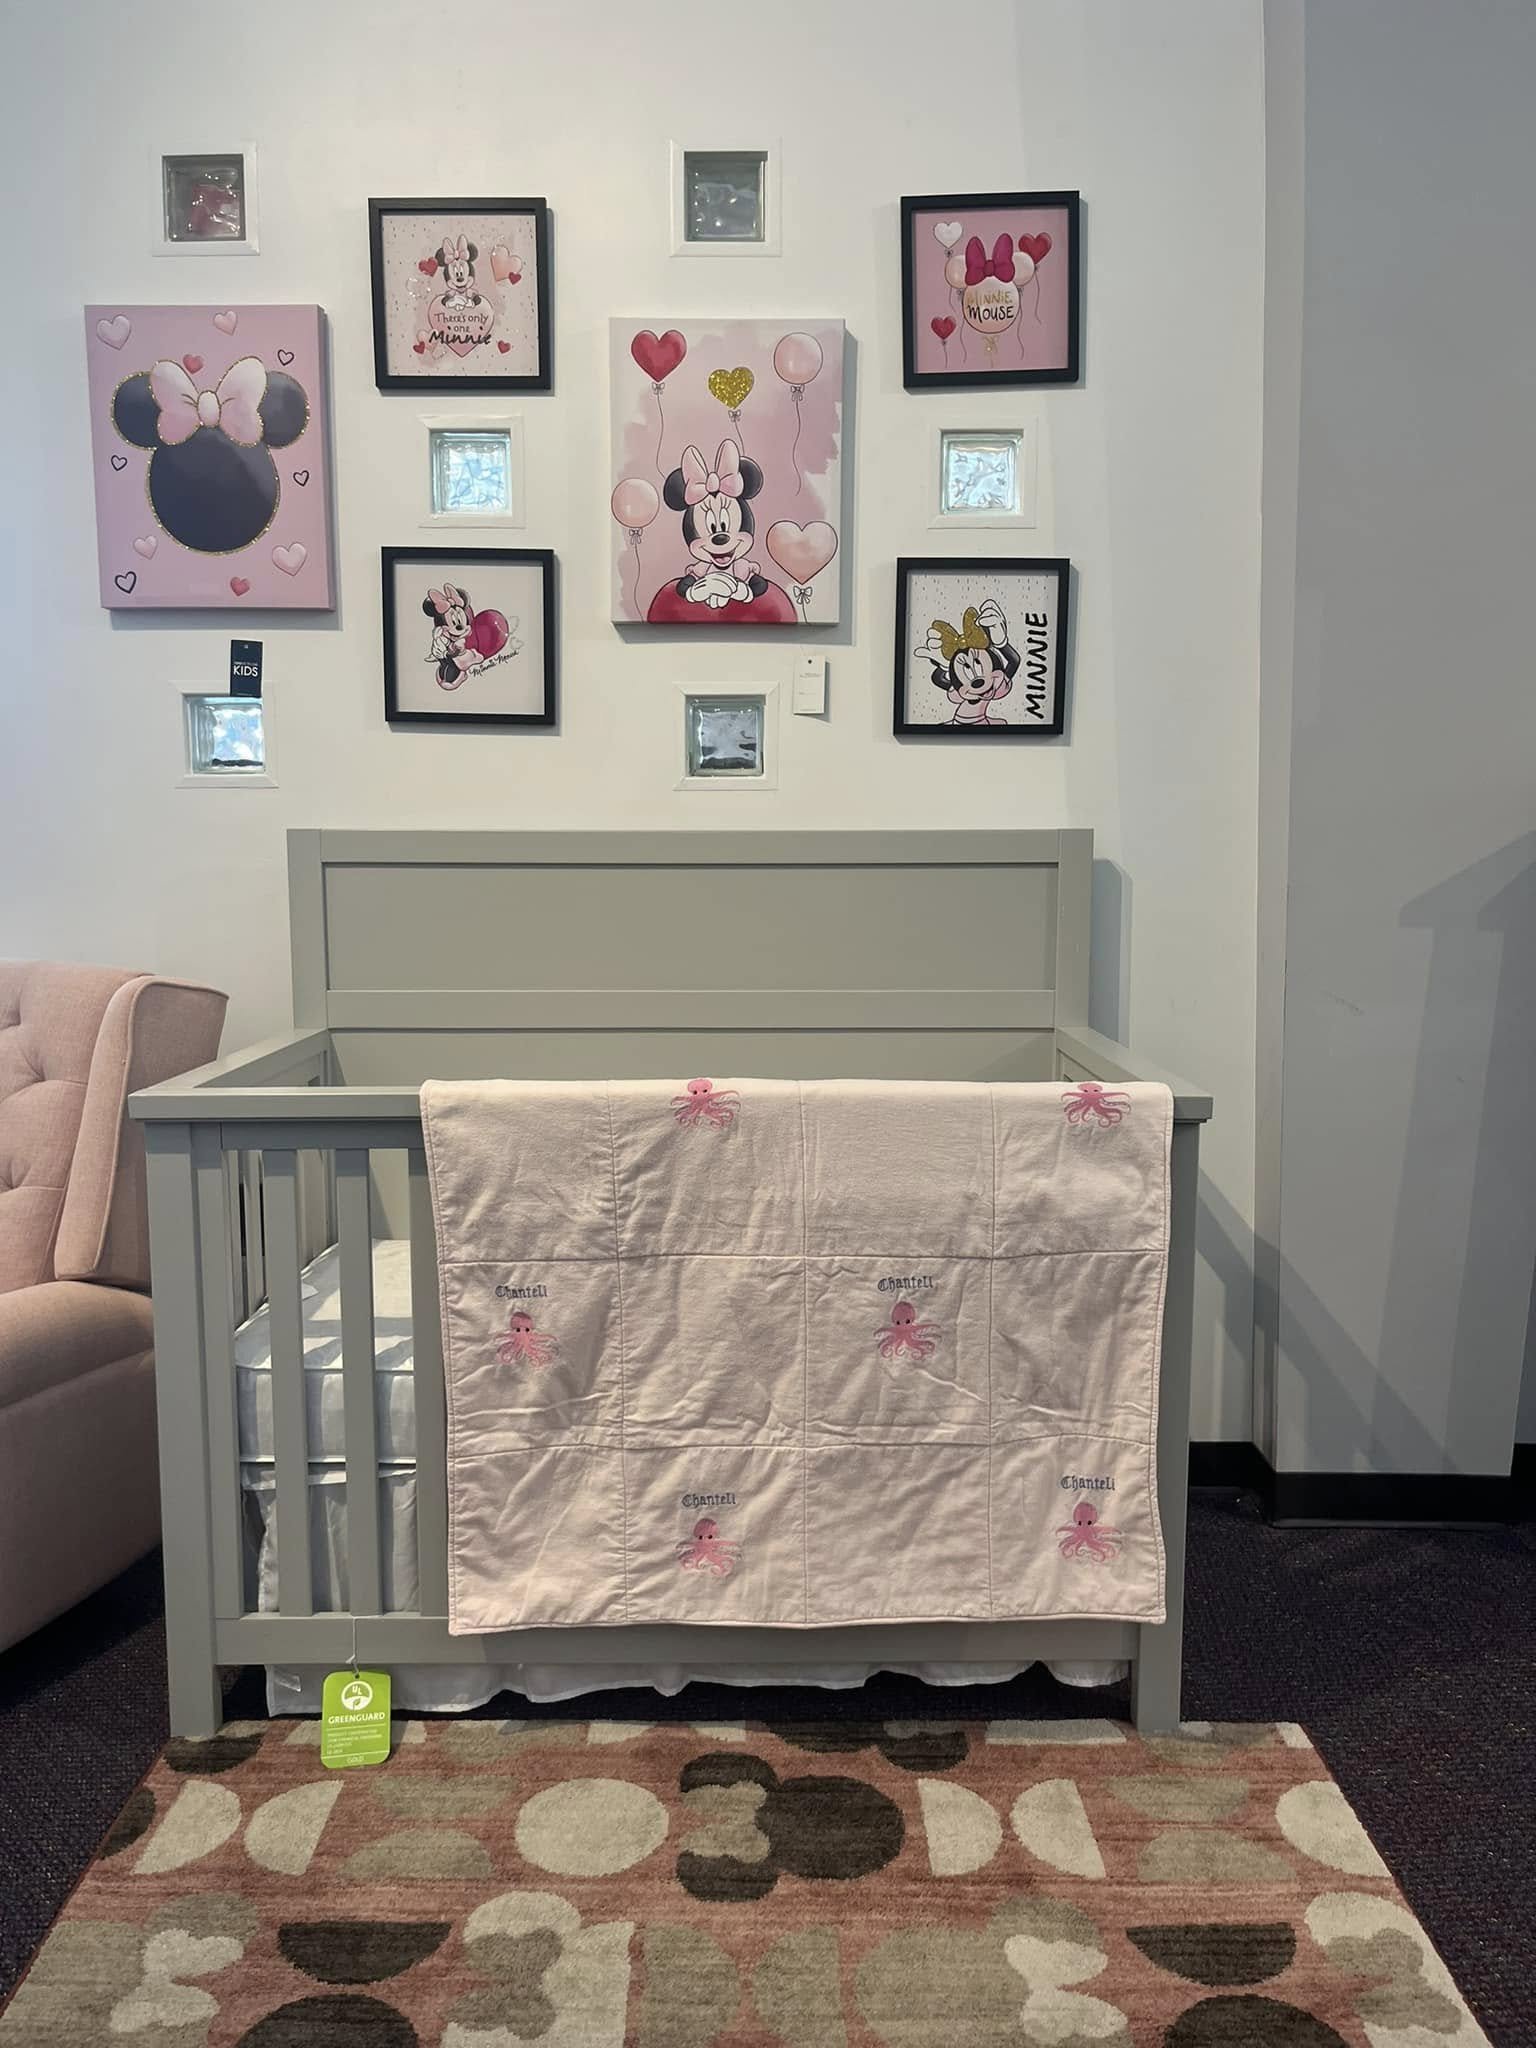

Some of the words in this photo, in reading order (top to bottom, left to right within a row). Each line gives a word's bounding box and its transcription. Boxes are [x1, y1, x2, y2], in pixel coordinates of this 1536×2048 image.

[434, 312, 466, 323] There's
[468, 313, 489, 326] only
[968, 305, 1014, 323] MOUSE
[453, 325, 470, 333] one
[428, 330, 492, 345] Minnie
[233, 665, 258, 677] KIDS
[1025, 613, 1048, 719] MINNIE
[352, 1685, 363, 1696] UL
[328, 1712, 386, 1724] GREENGUARD
